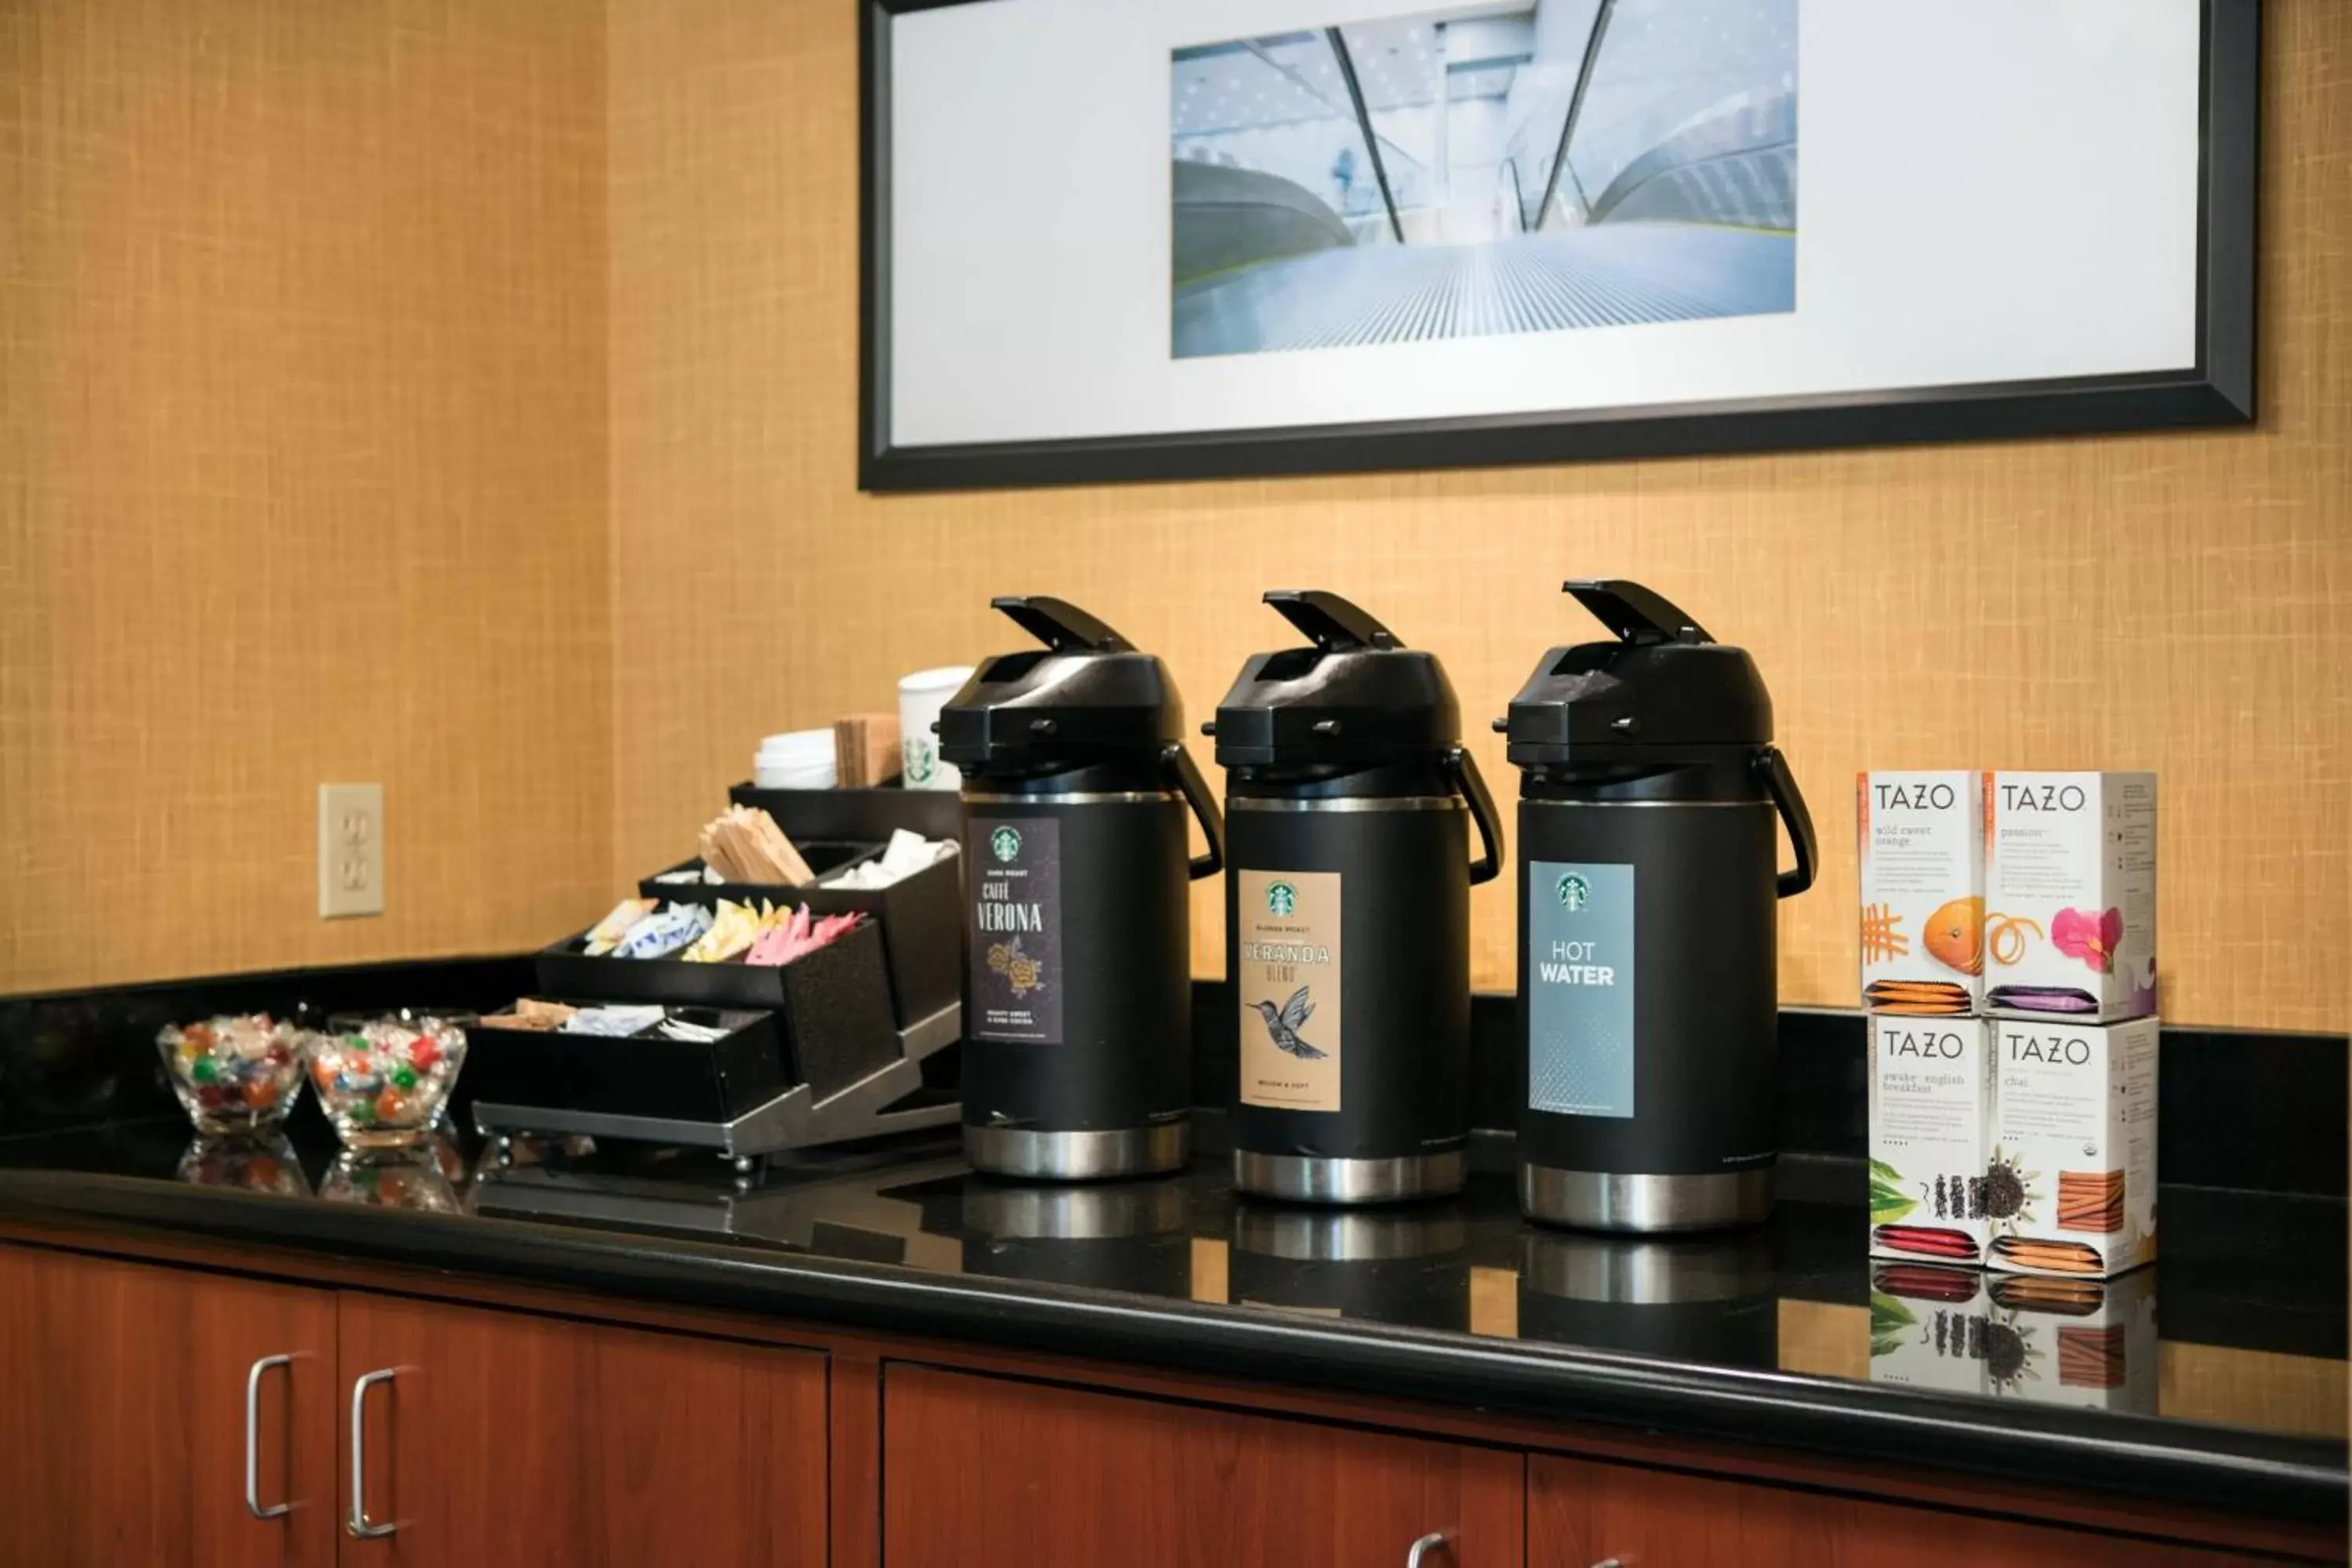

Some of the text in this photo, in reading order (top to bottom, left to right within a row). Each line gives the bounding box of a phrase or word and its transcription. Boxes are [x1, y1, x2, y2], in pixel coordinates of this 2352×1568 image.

[1875, 783, 1955, 810] TAZO
[2001, 785, 2085, 811] TAZO
[1875, 837, 1911, 848] orange
[1900, 826, 1932, 836] sweet
[977, 902, 1043, 931] VERONA
[1243, 941, 1330, 964] VERANDA
[1552, 940, 1595, 962] HOT
[1539, 962, 1615, 985] WATER
[1884, 1031, 1963, 1058] TAZO
[2005, 1034, 2090, 1065] TAZO
[1926, 1074, 1965, 1087] english
